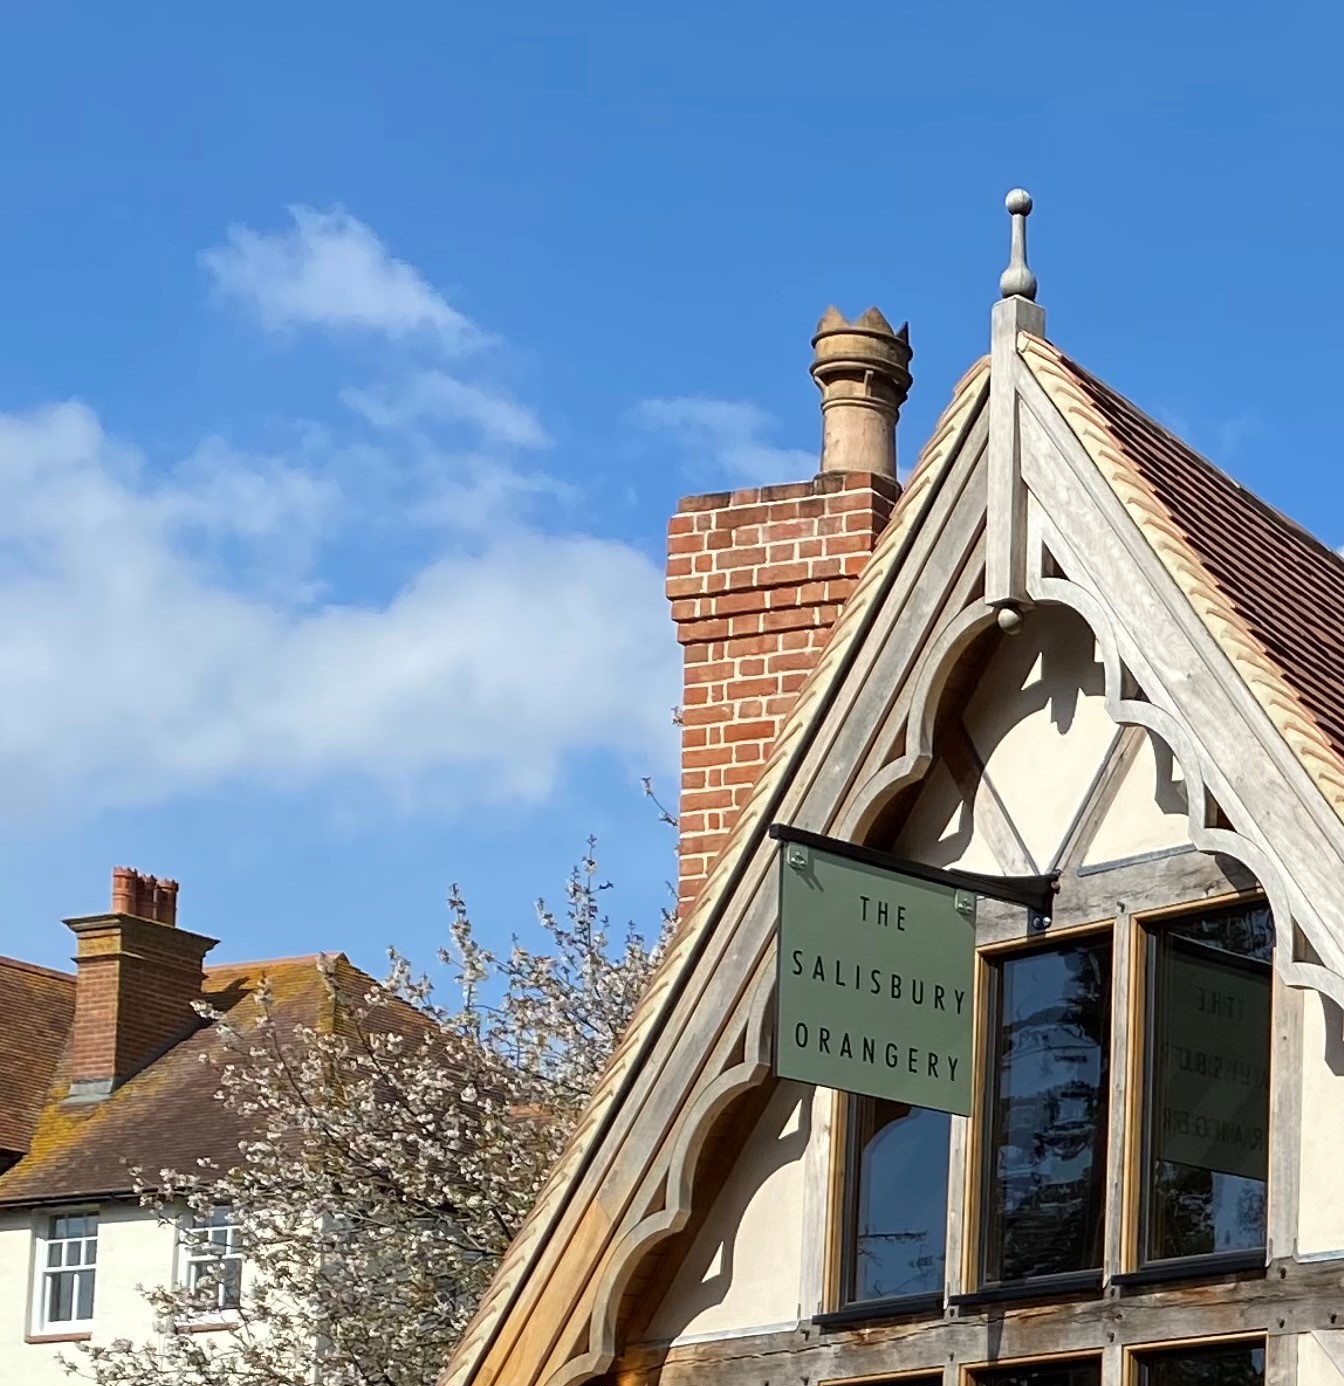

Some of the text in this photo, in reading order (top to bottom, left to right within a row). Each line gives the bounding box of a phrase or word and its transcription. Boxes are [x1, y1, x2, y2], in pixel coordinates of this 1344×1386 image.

[860, 895, 907, 932] THE
[791, 949, 966, 1015] SALISBURY
[794, 1021, 960, 1082] ORANGERY
